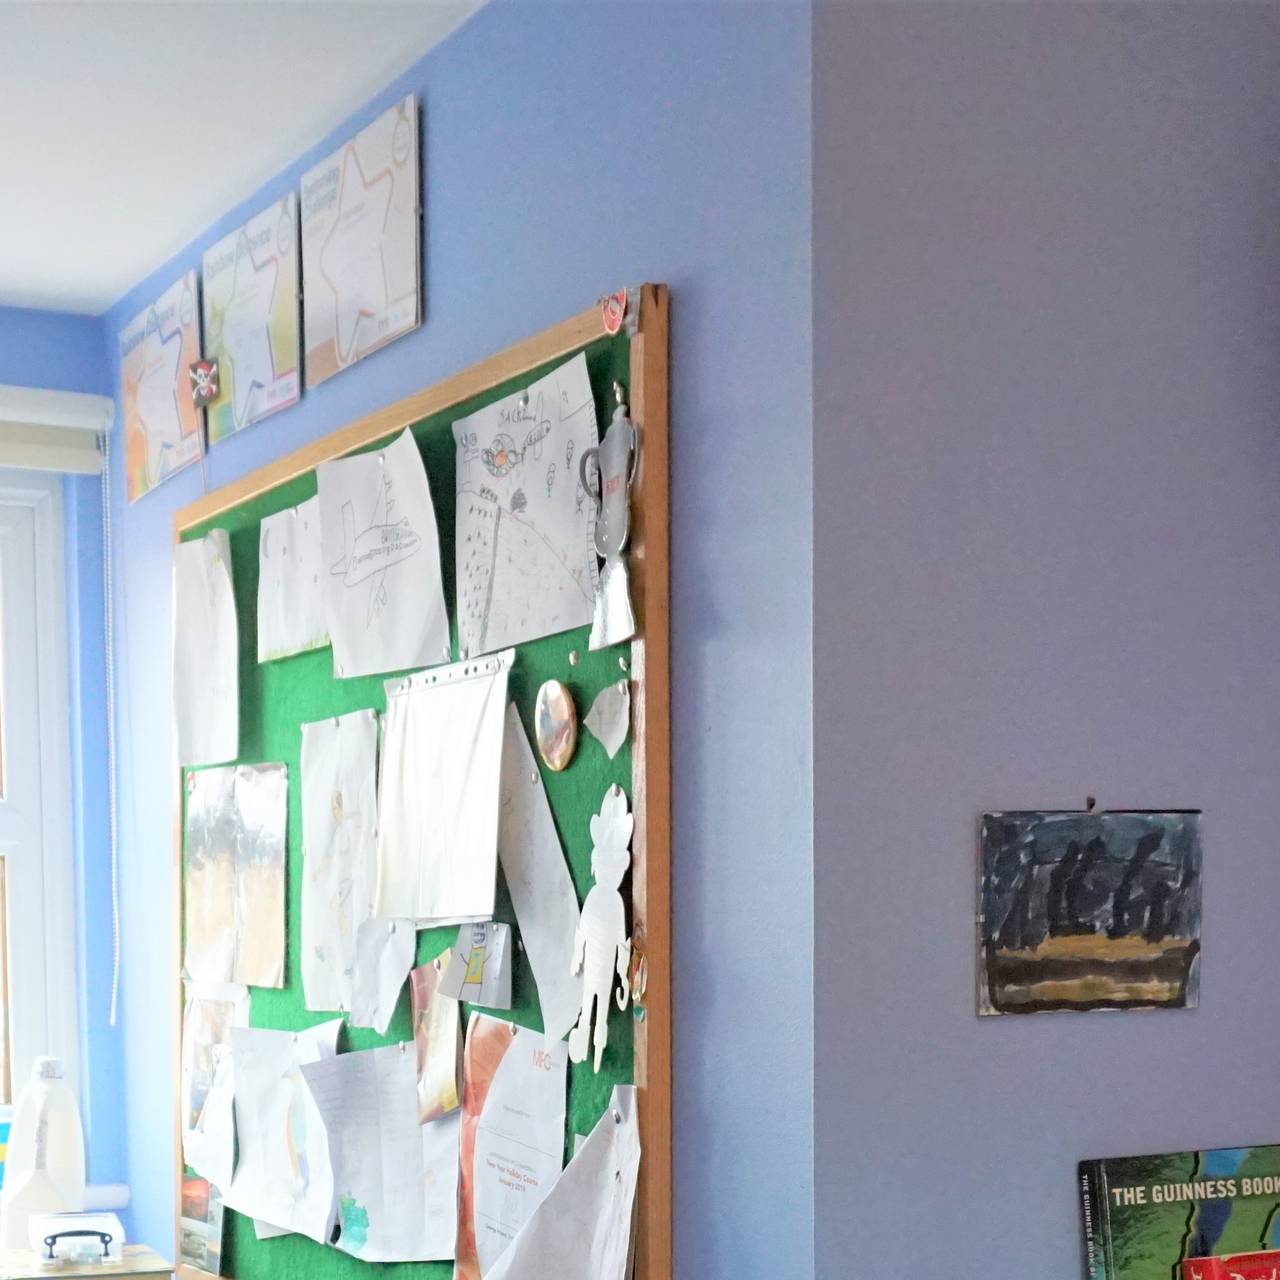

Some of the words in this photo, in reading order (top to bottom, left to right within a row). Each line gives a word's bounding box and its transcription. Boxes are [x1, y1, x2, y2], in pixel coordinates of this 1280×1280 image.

[1112, 1185, 1147, 1207] THE
[1151, 1179, 1237, 1205] GUINNESS
[1083, 1194, 1093, 1239] GUINNESS
[1086, 1240, 1096, 1264] BOOK
